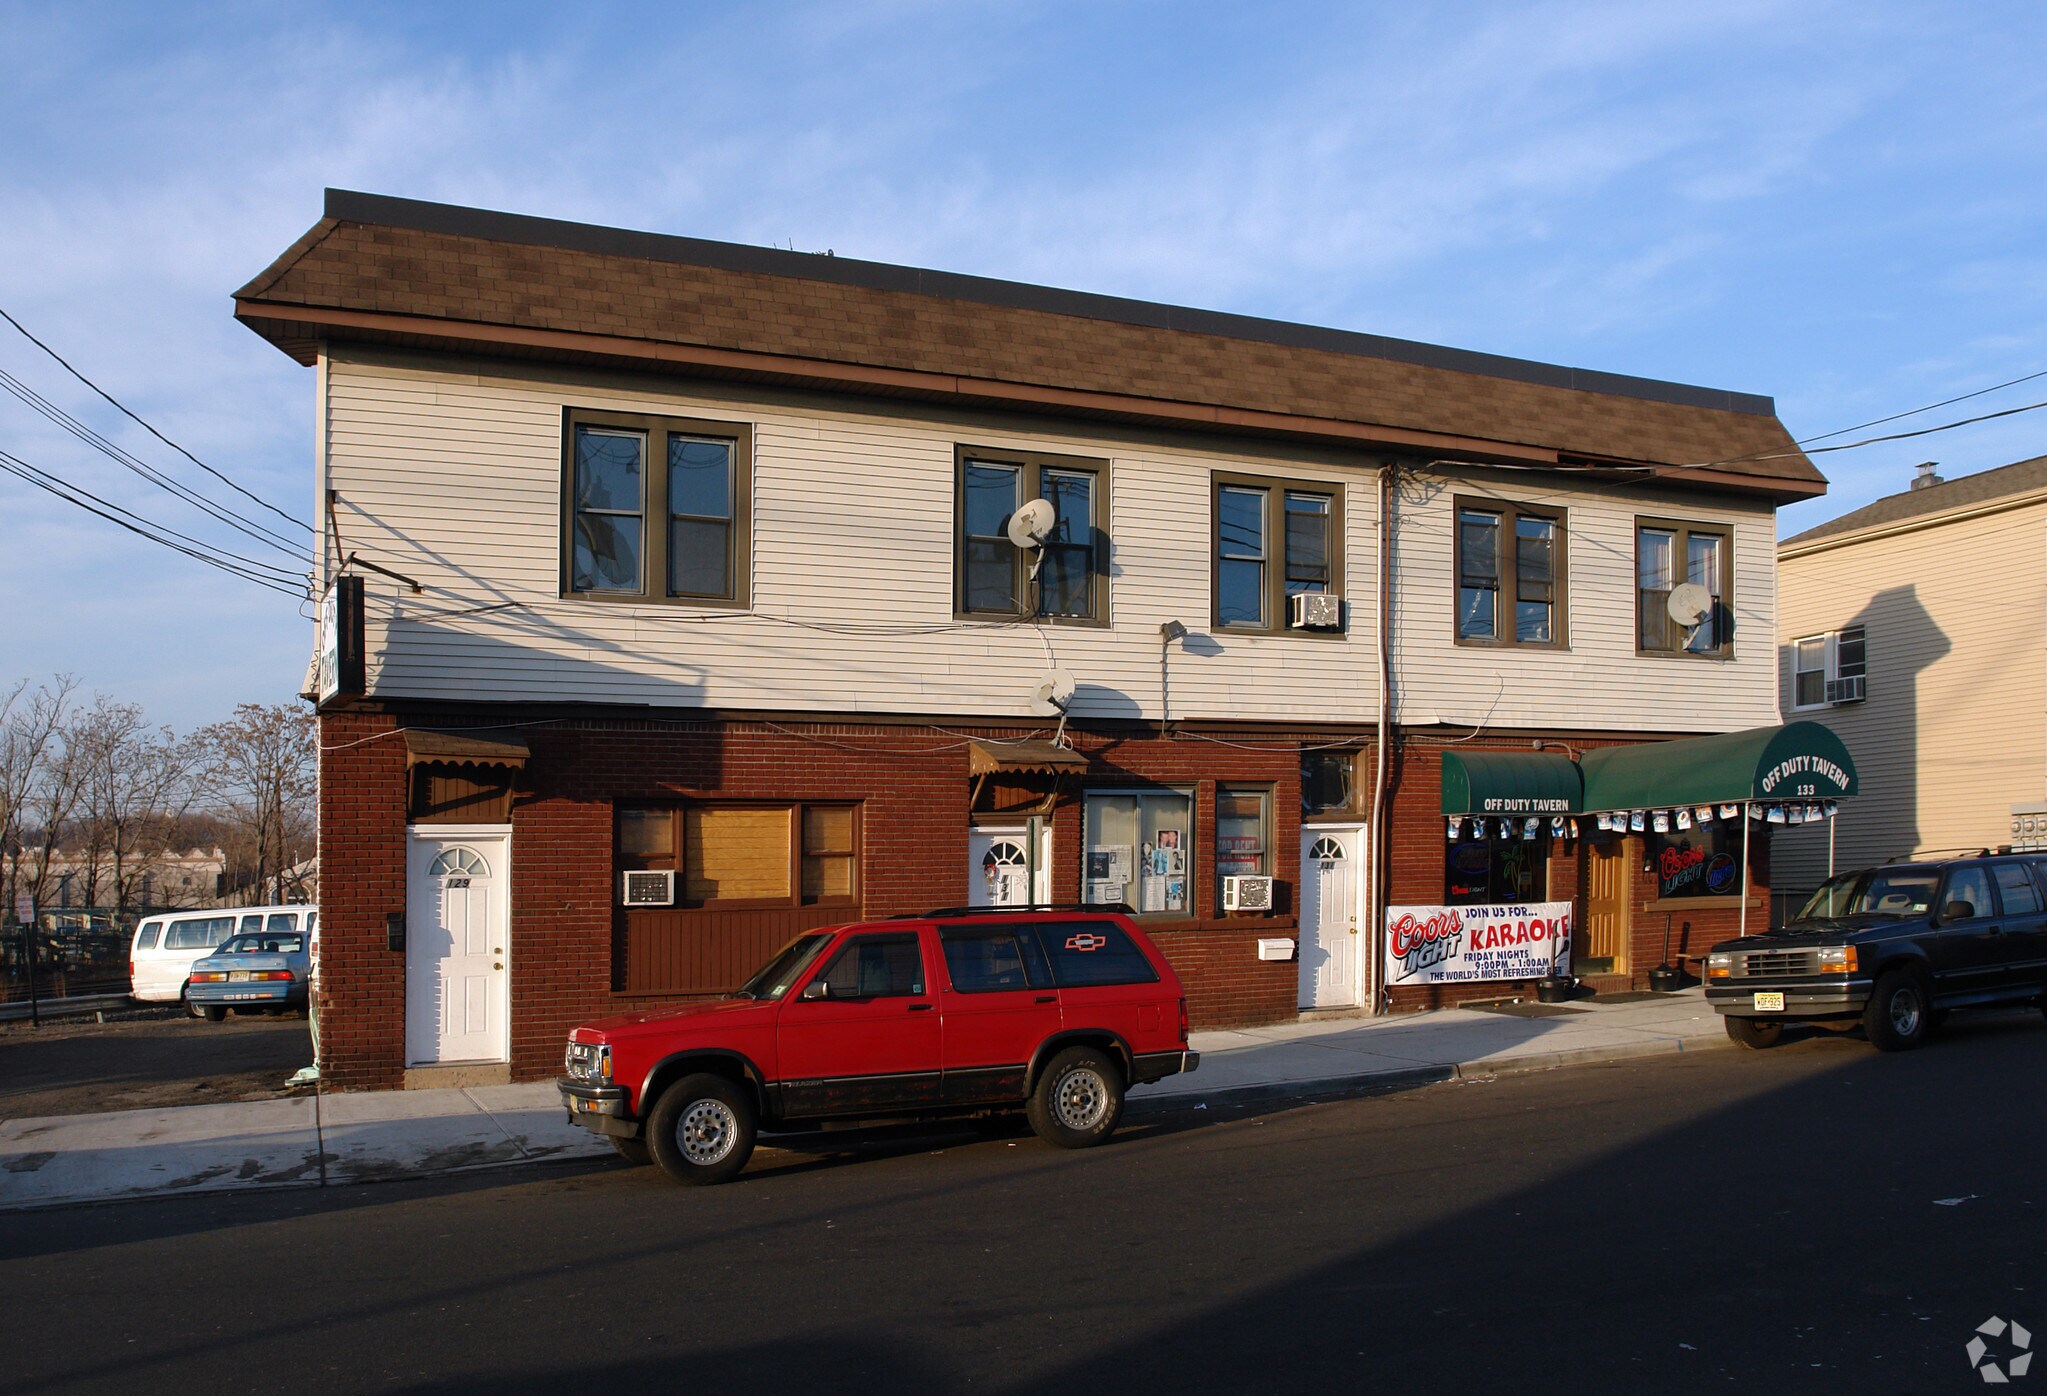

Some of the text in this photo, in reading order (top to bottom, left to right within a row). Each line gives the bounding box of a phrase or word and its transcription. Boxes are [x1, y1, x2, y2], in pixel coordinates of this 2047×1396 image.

[1762, 755, 1850, 793] OFF DUTY TAVERN
[1796, 784, 1815, 796] 133
[1484, 798, 1569, 812] OFF DUTY TAVERN
[447, 878, 471, 888] 129
[1465, 906, 1538, 919] JOIN US FOR...
[1389, 909, 1463, 959] Coors
[1470, 914, 1569, 952] KARAOKE
[1396, 934, 1462, 982] LIGHT
[1464, 949, 1529, 962] FRIDAY NIGHTS
[1475, 960, 1509, 970] 9:00PM
[1518, 957, 1550, 967] 1:00AM
[1430, 965, 1562, 981] THE WORLD'S MOST REFRESHING BER
